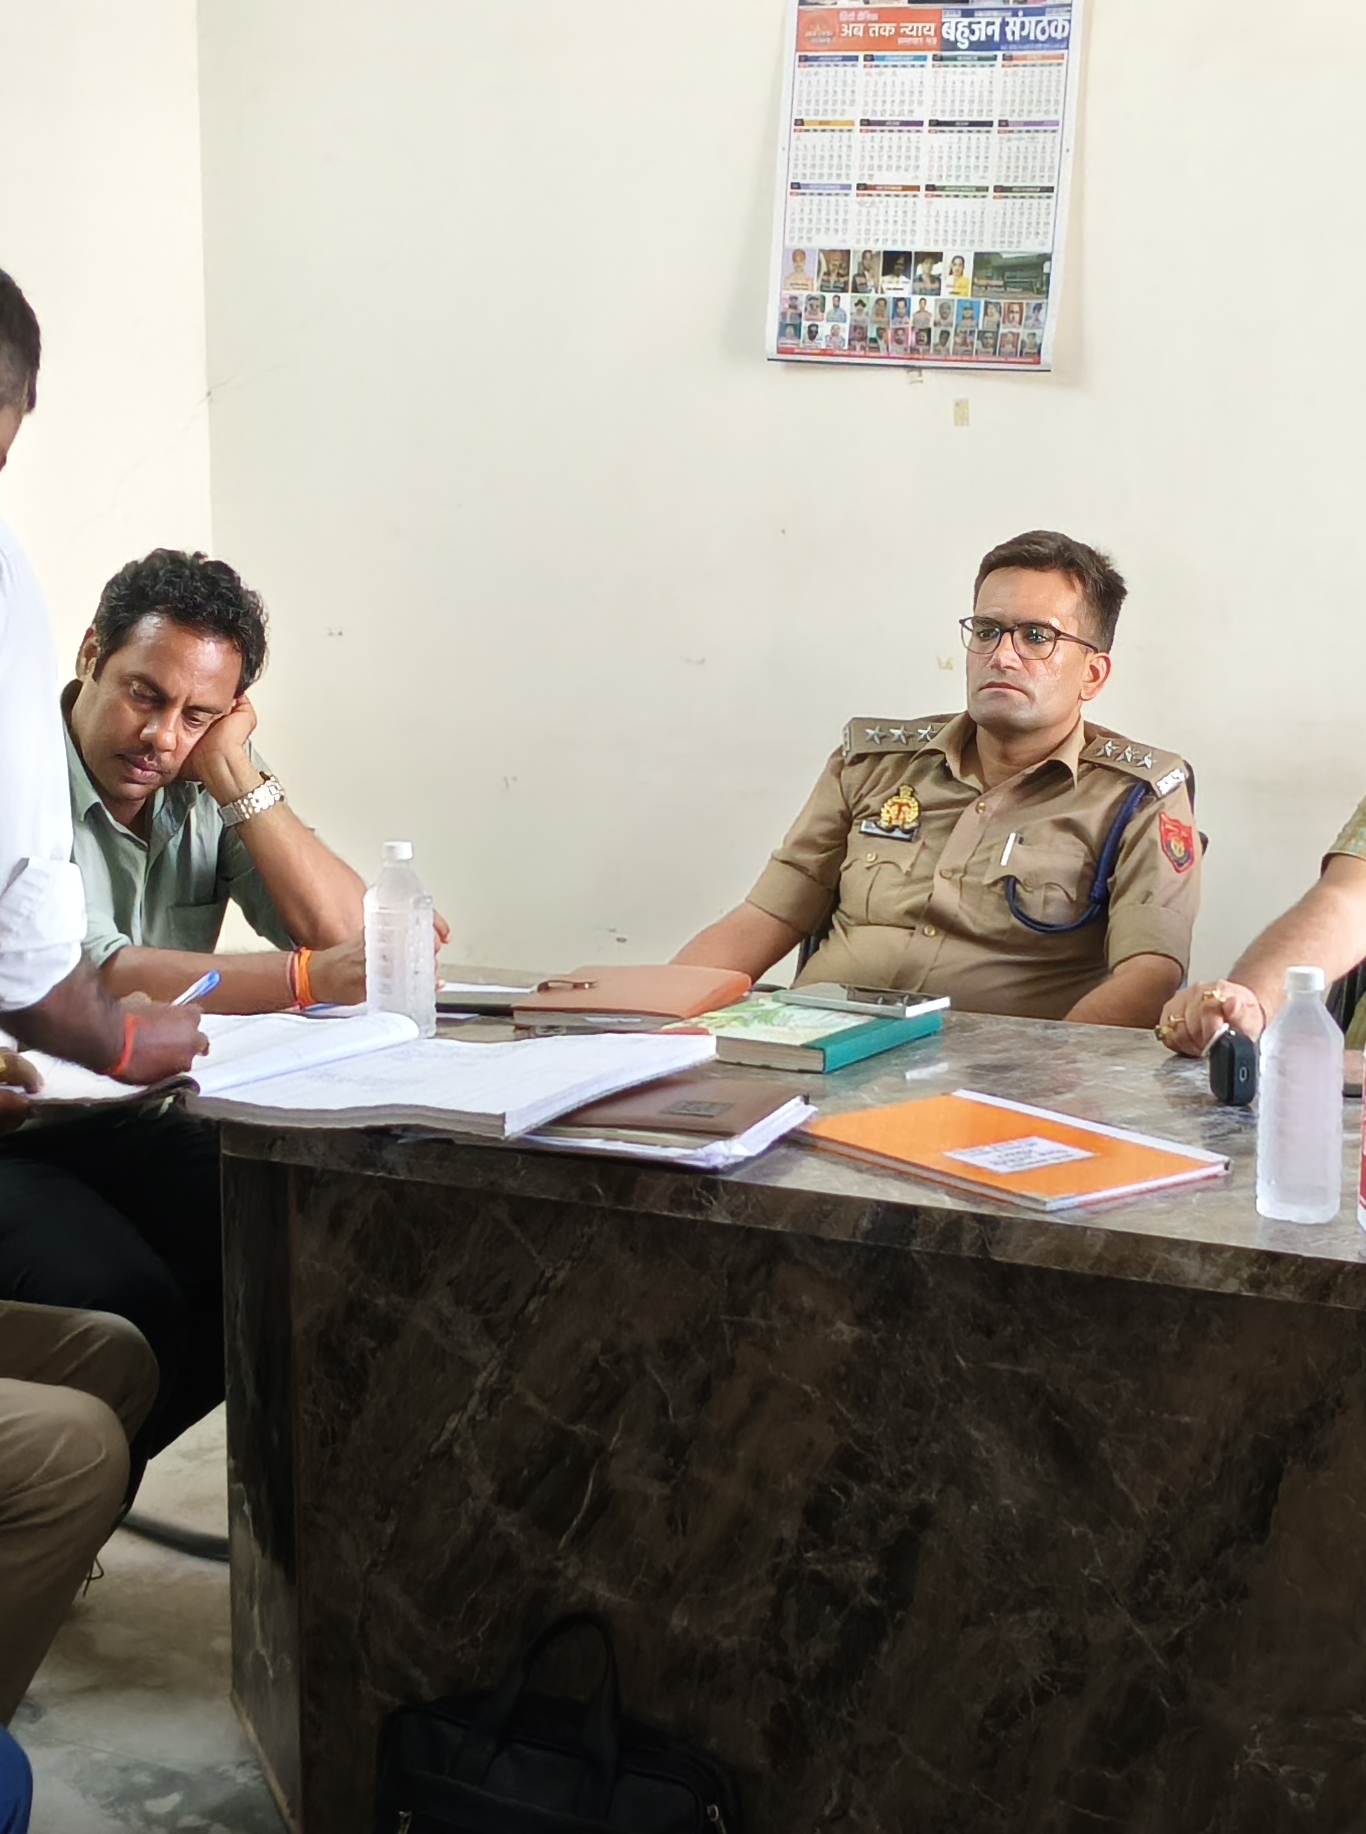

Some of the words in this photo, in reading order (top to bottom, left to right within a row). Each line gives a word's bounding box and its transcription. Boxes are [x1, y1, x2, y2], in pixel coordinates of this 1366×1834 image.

[840, 23, 865, 37] अब
[868, 23, 896, 37] तक
[899, 23, 936, 37] न्याय
[941, 17, 1002, 49] बहुजन
[1005, 10, 1070, 42] संगठक
